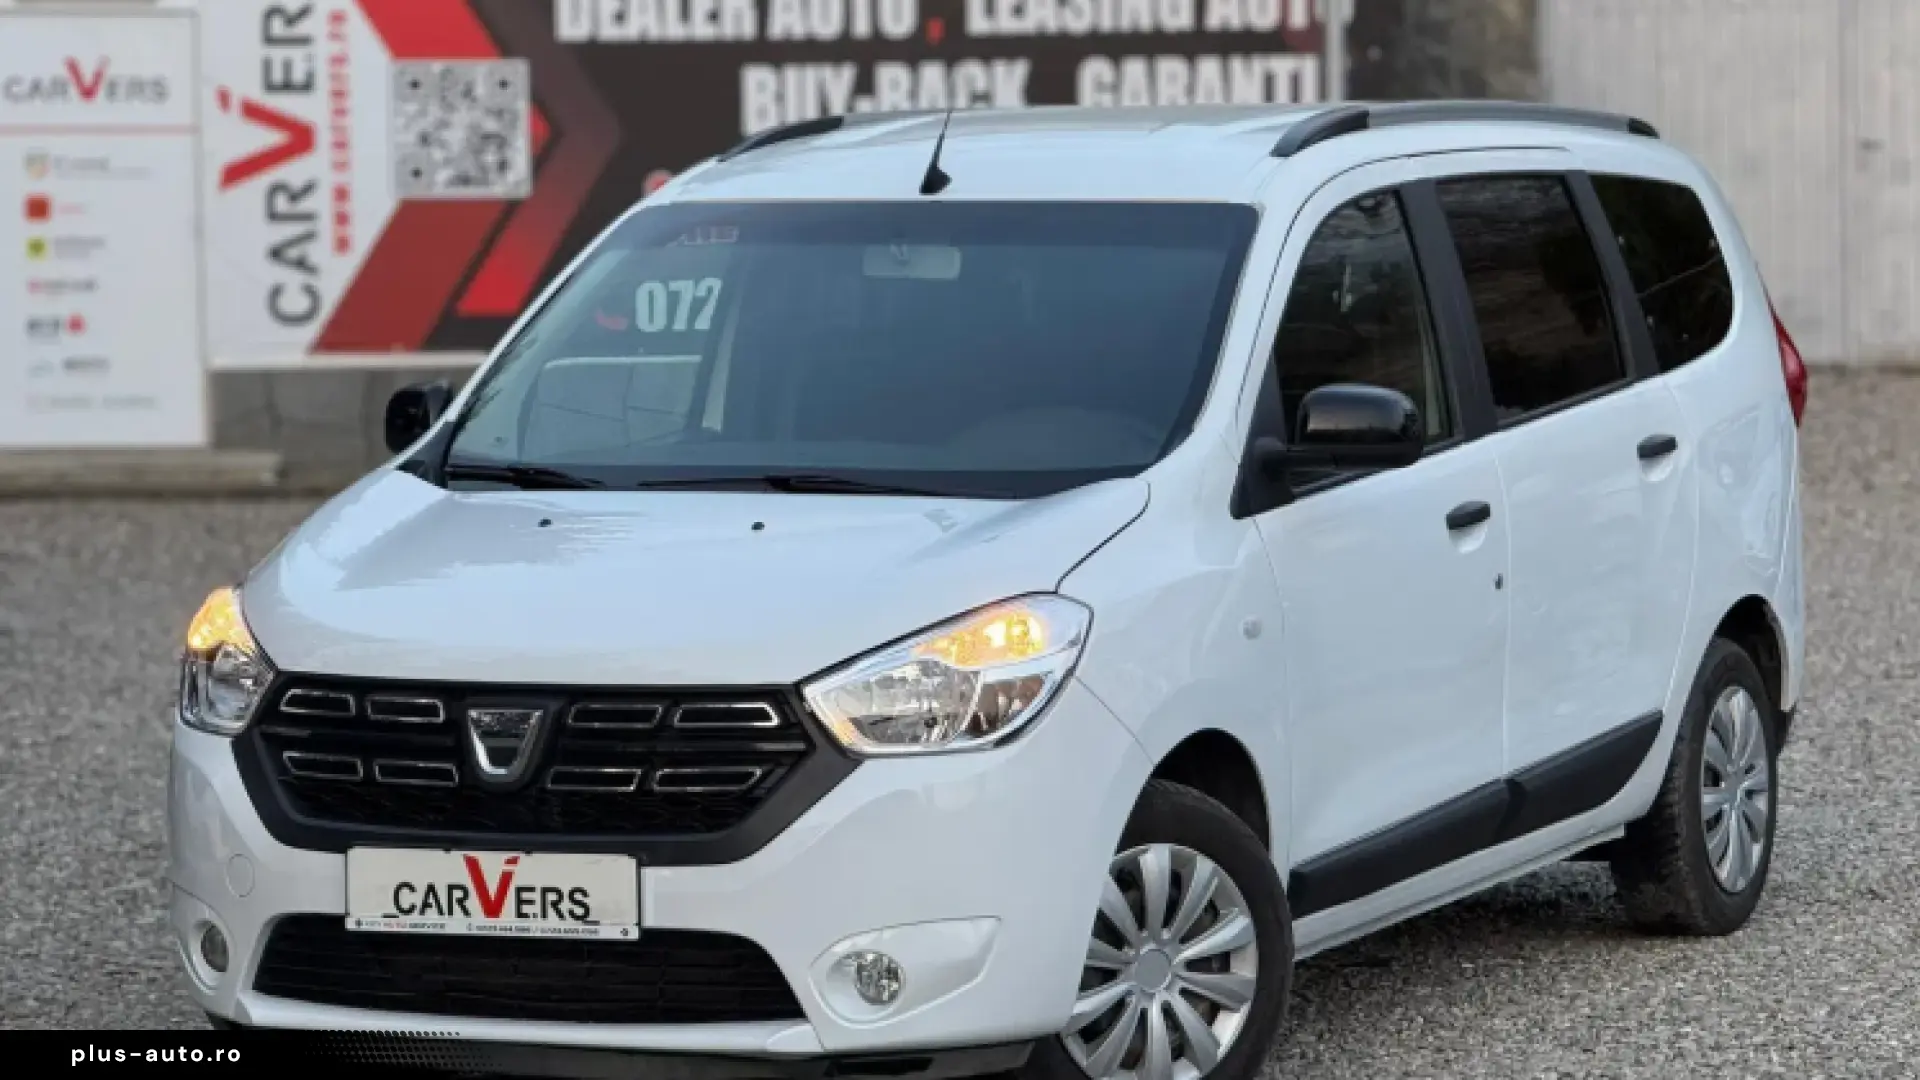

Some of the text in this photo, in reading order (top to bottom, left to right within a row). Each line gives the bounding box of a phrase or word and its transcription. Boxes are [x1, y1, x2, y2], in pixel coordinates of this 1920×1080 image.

[554, 0, 758, 42] DEALER
[1202, 0, 1355, 31] AUT
[1, 55, 170, 103] CARVERS
[741, 60, 1031, 135] BUY-BACK
[635, 277, 723, 332] 072
